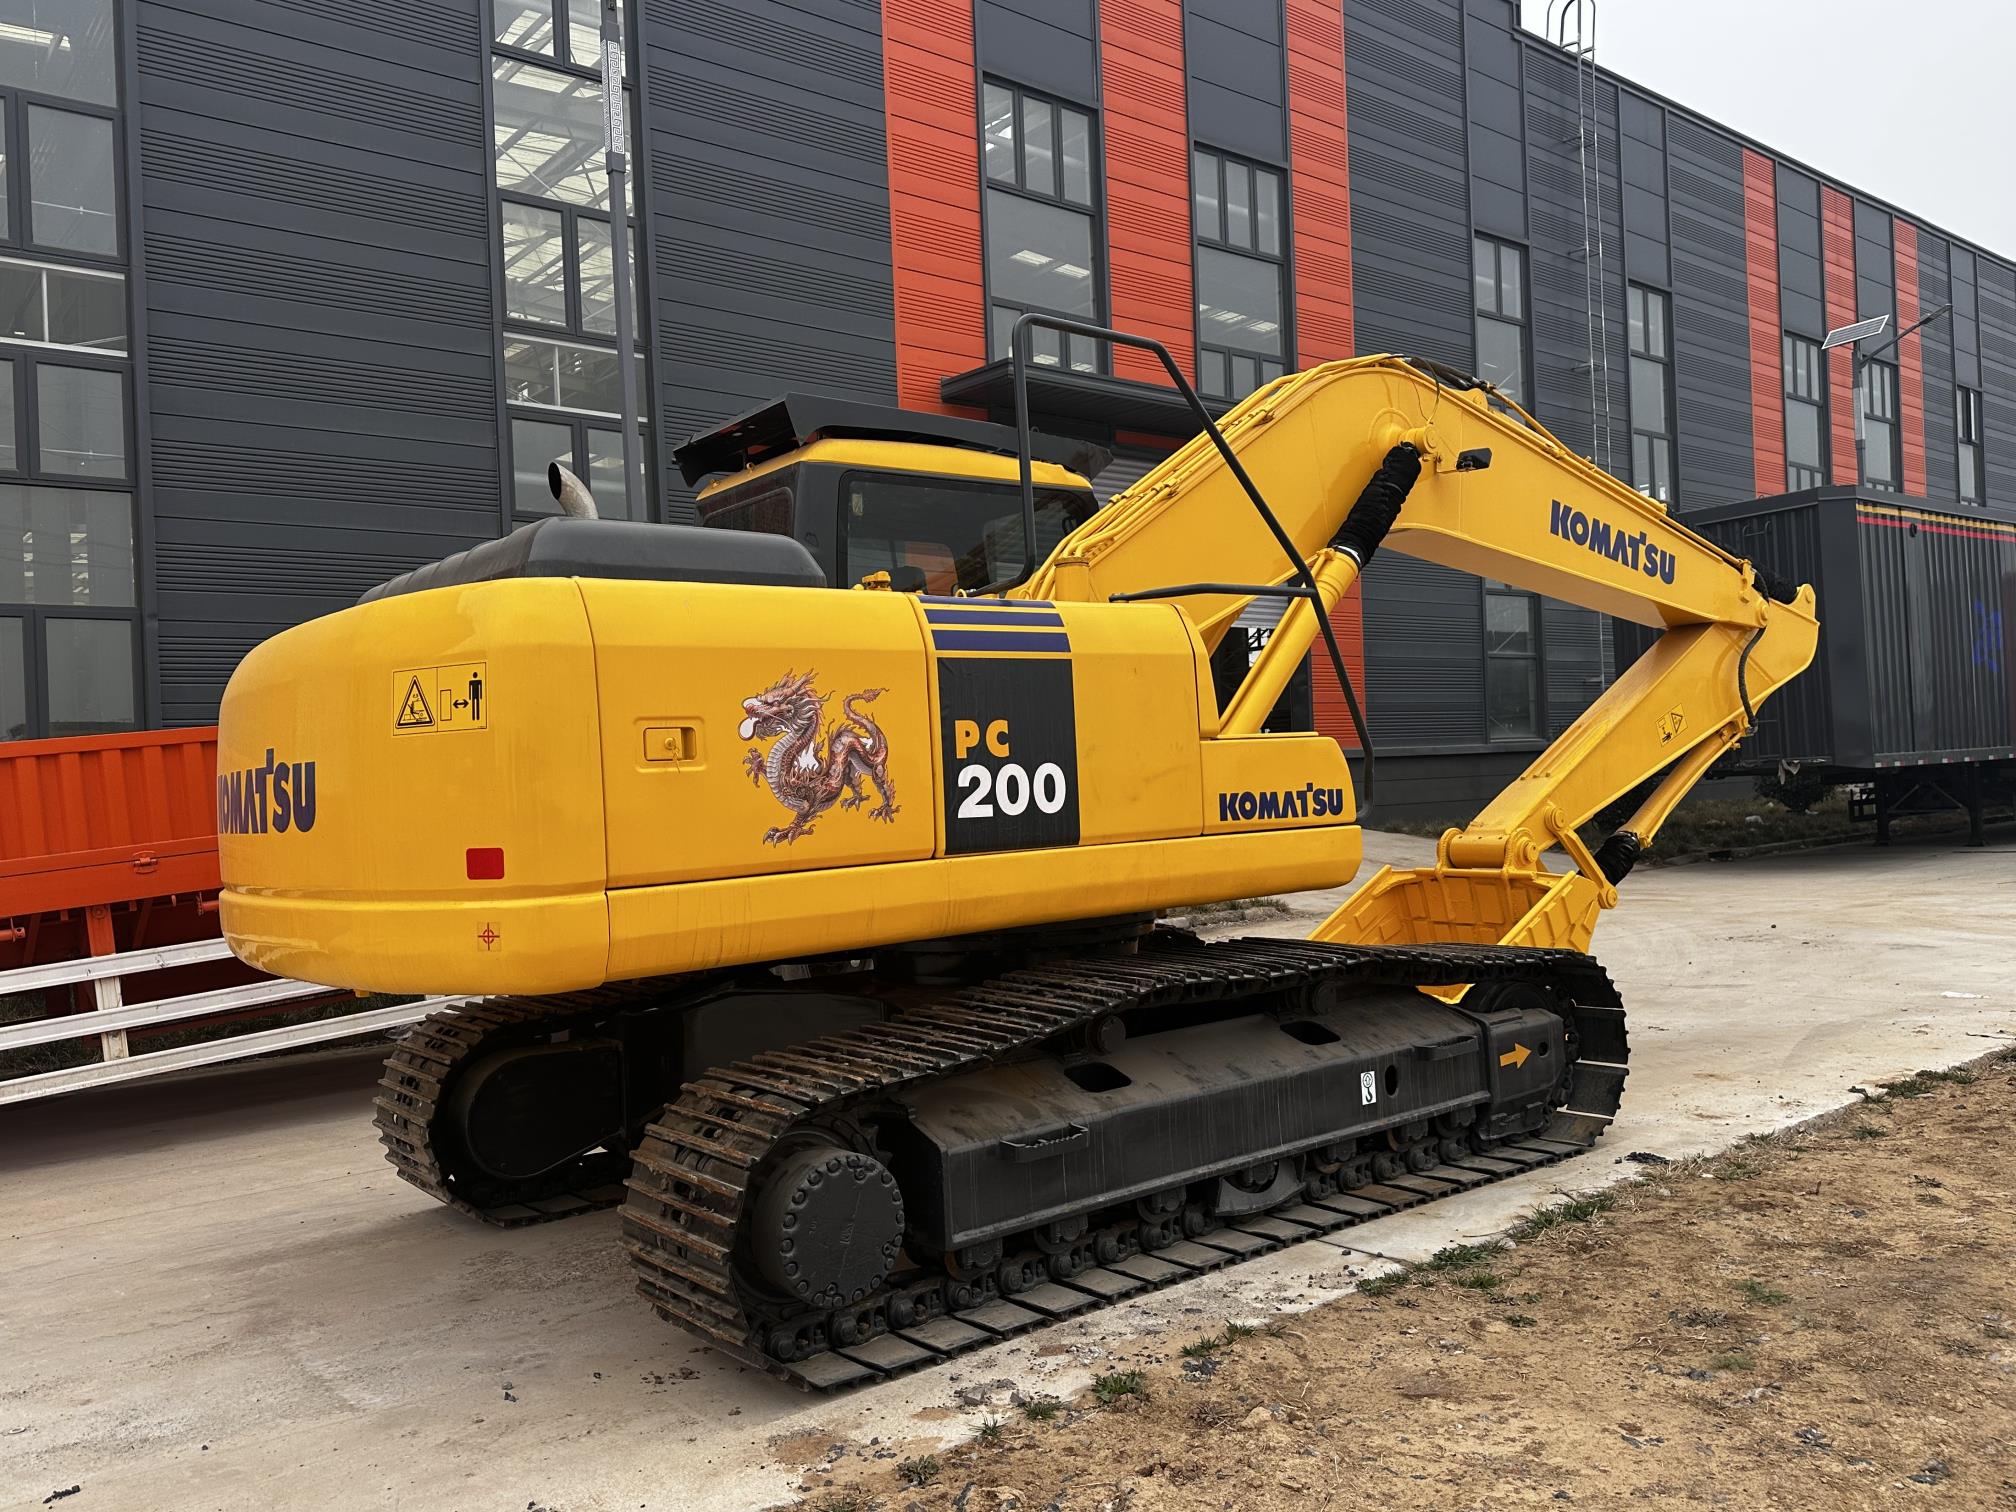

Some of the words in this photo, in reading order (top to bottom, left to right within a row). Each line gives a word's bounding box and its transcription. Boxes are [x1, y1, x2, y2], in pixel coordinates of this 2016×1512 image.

[1550, 499, 1676, 585] KOMATSU
[955, 719, 1010, 759] PC
[957, 762, 1067, 819] 200
[1219, 782, 1344, 822] KOMATSU
